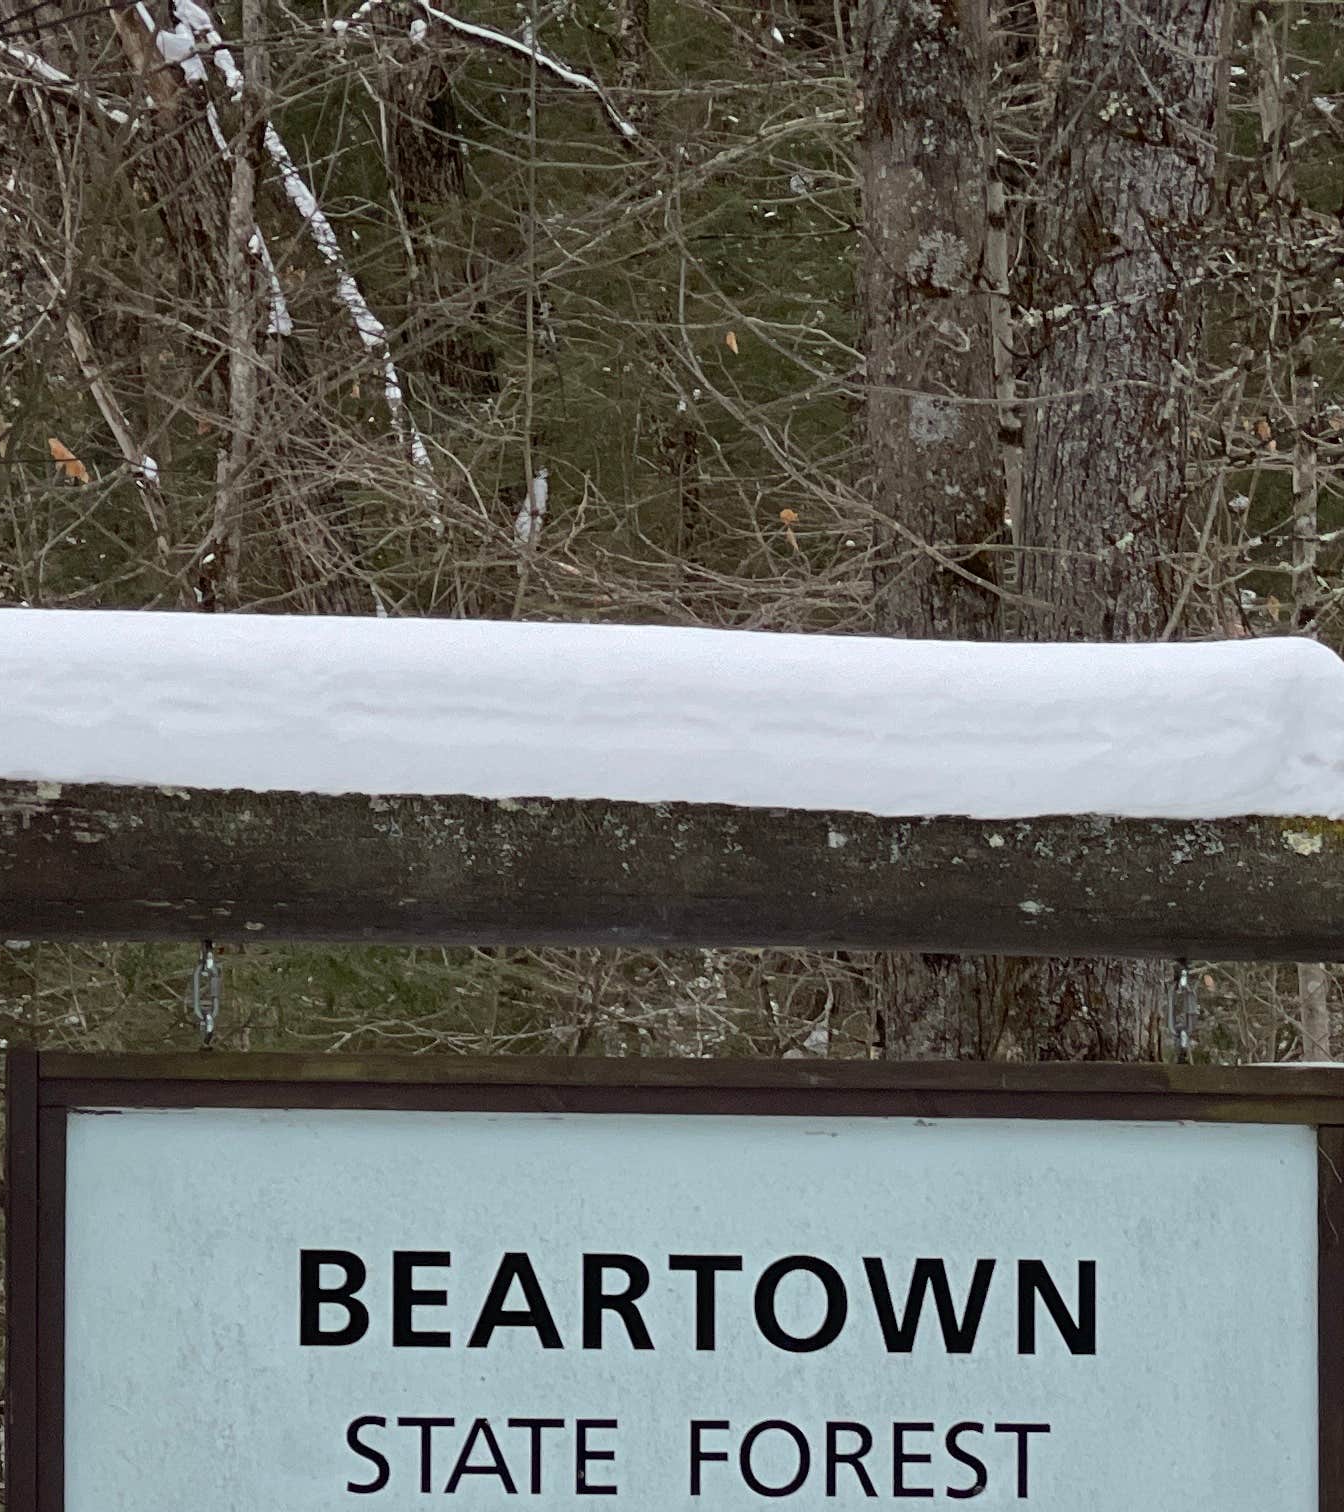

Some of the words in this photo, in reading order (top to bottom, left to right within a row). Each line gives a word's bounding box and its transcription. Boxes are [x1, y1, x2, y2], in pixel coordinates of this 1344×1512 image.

[298, 1248, 1097, 1356] BEARTOWN
[346, 1415, 619, 1496] STATE
[689, 1419, 1051, 1499] FOREST
